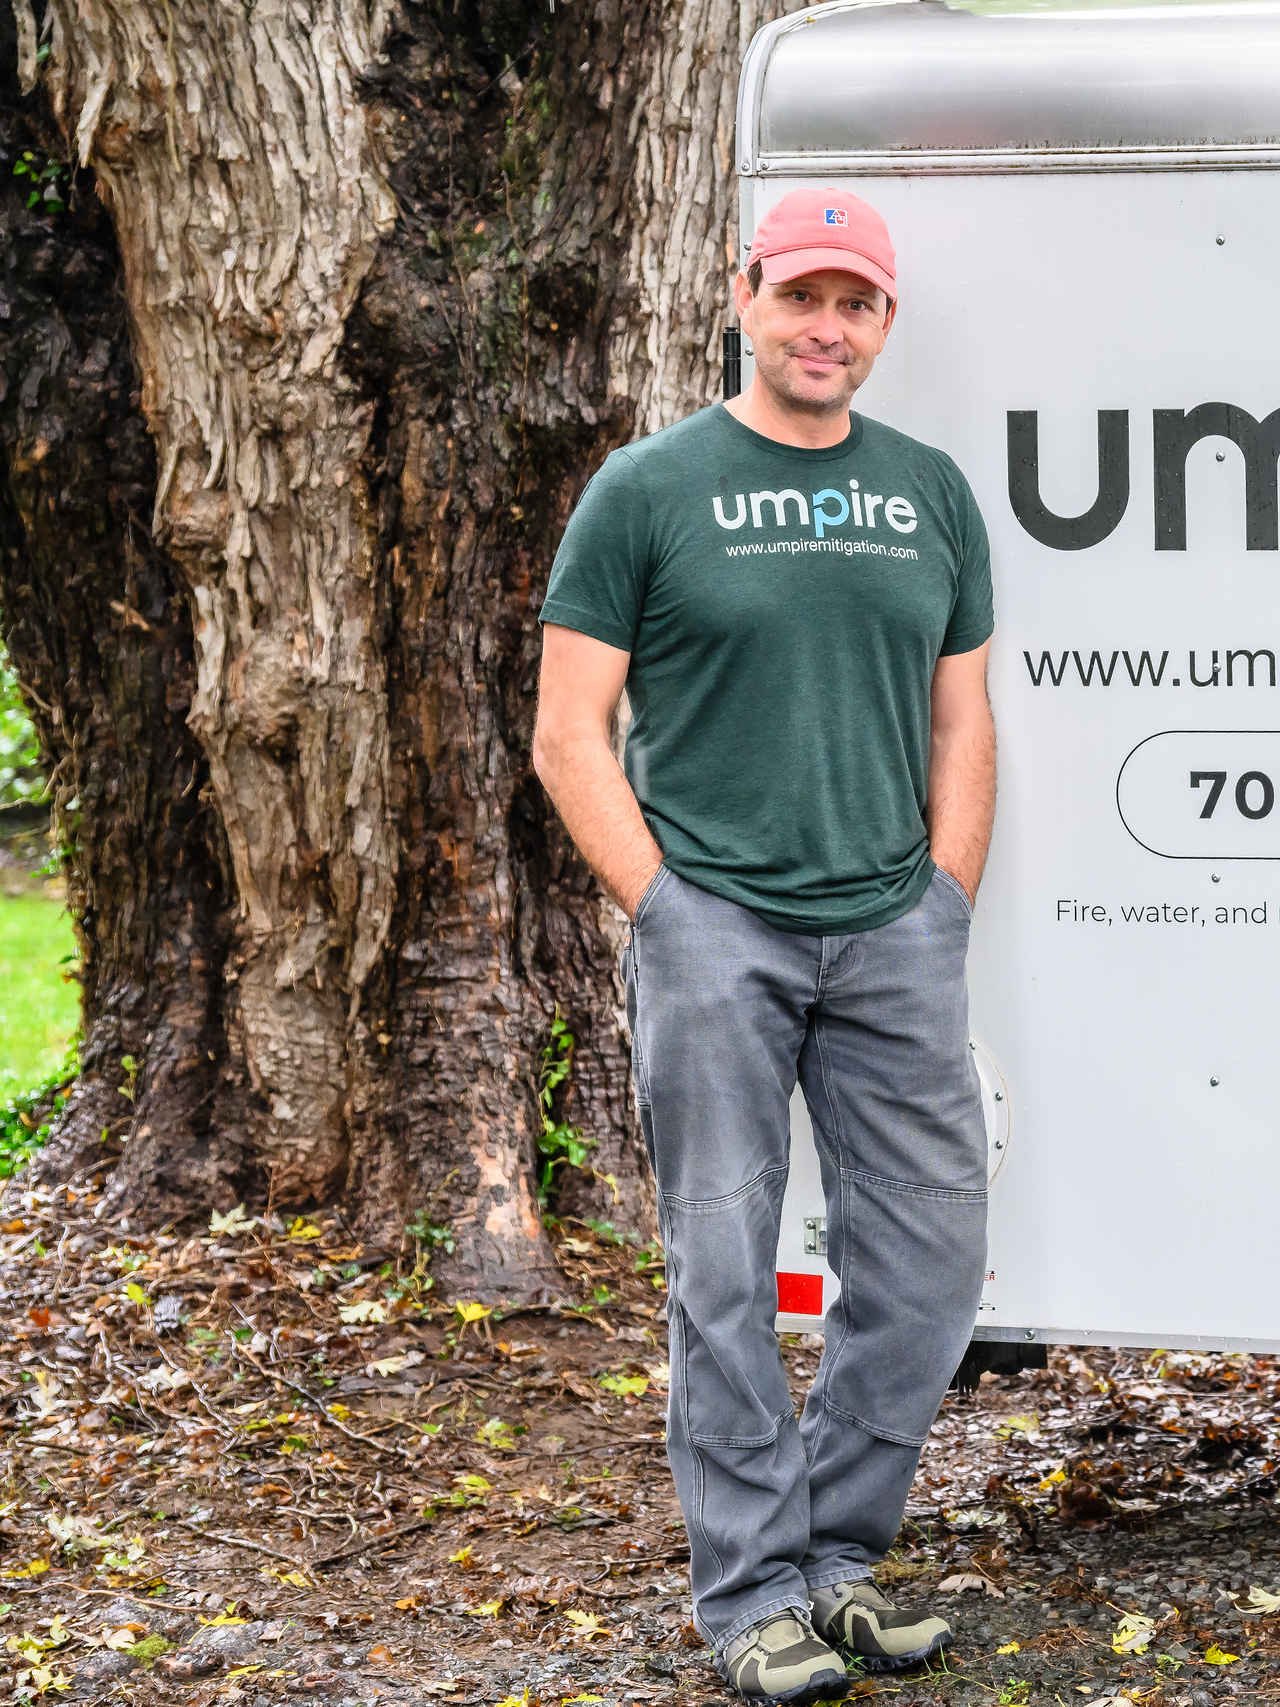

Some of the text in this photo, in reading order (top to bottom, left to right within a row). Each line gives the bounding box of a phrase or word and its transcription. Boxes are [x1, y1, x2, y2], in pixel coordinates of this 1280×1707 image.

[712, 478, 918, 538] umpire
[725, 538, 919, 561] www.umpiremitigation.com
[1055, 900, 1113, 927] Fire,
[1120, 903, 1206, 929] water,
[1214, 901, 1267, 925] and
